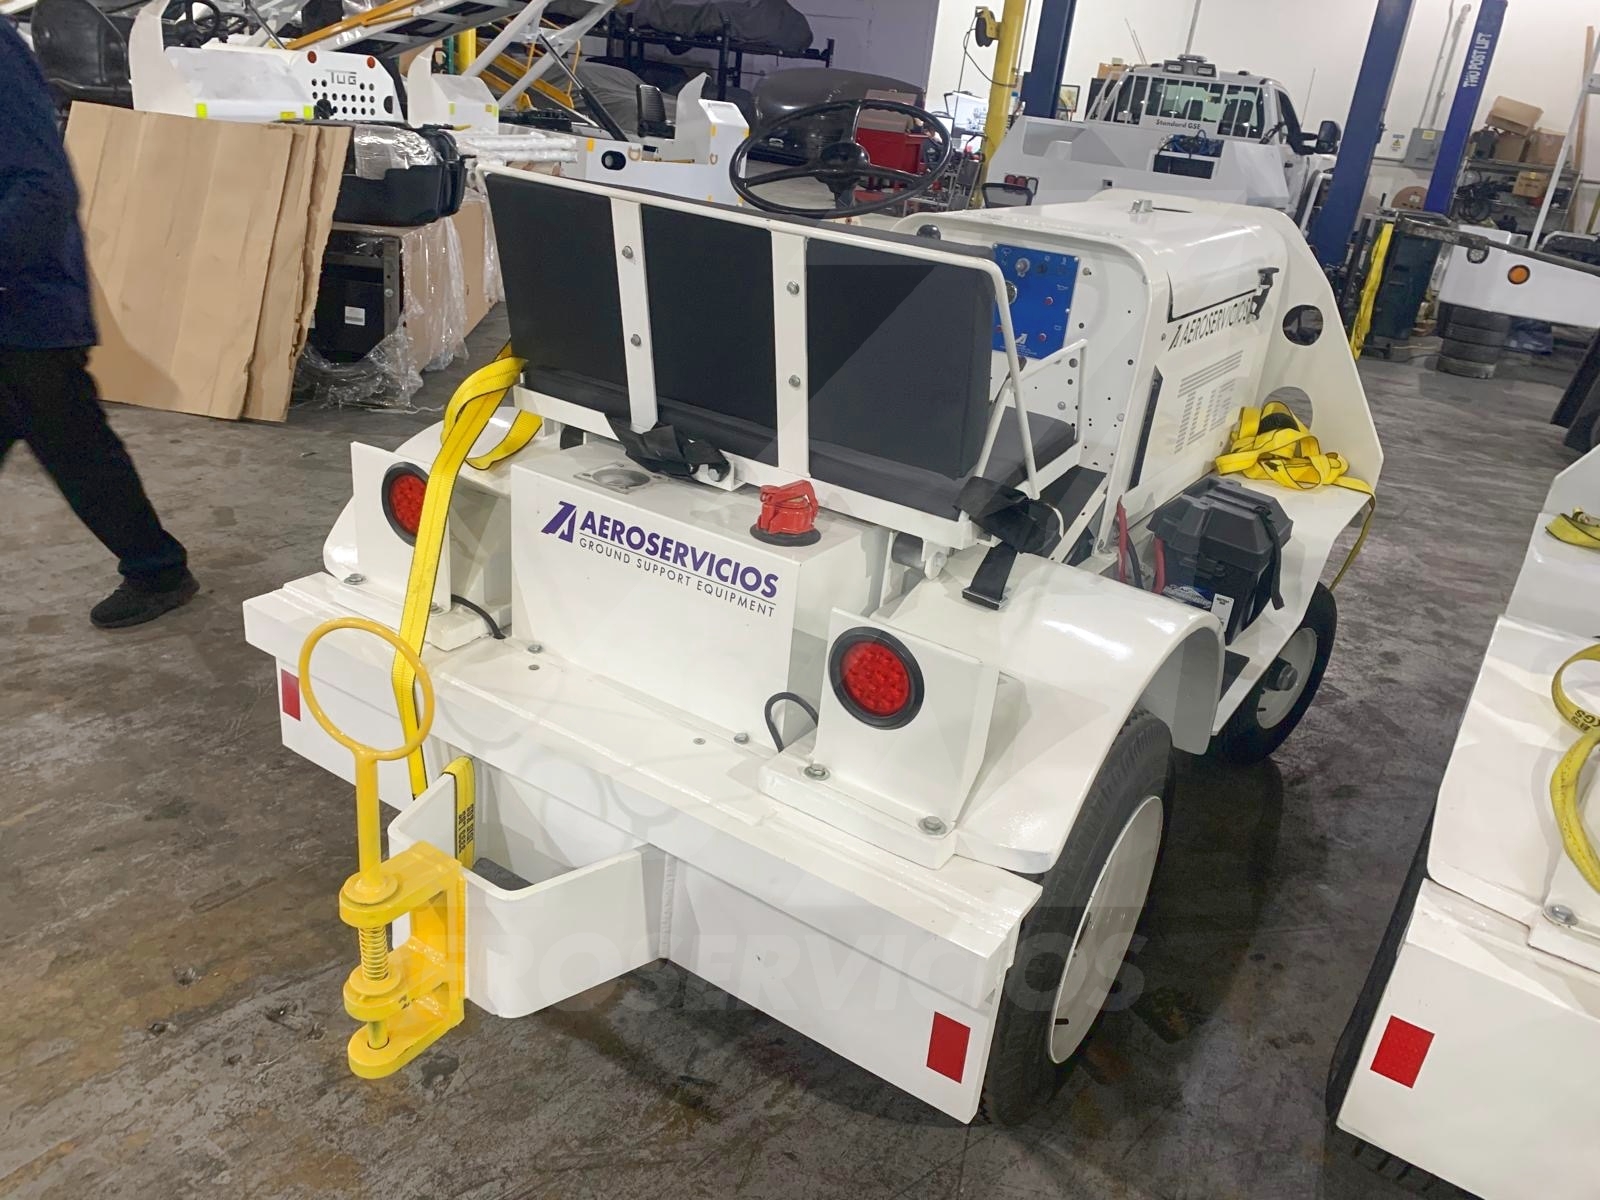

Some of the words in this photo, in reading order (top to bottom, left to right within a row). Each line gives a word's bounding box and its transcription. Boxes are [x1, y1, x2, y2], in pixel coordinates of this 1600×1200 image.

[1474, 32, 1492, 49] LIFT
[1468, 49, 1487, 71] POST
[325, 69, 357, 85] TUG
[1462, 70, 1480, 88] TWO
[1156, 119, 1187, 128] Standard
[579, 510, 779, 599] AEROSERVICIOS
[579, 537, 631, 564] GROUND
[636, 558, 692, 587] SUPPORT
[696, 580, 775, 618] EQUIPMENT
